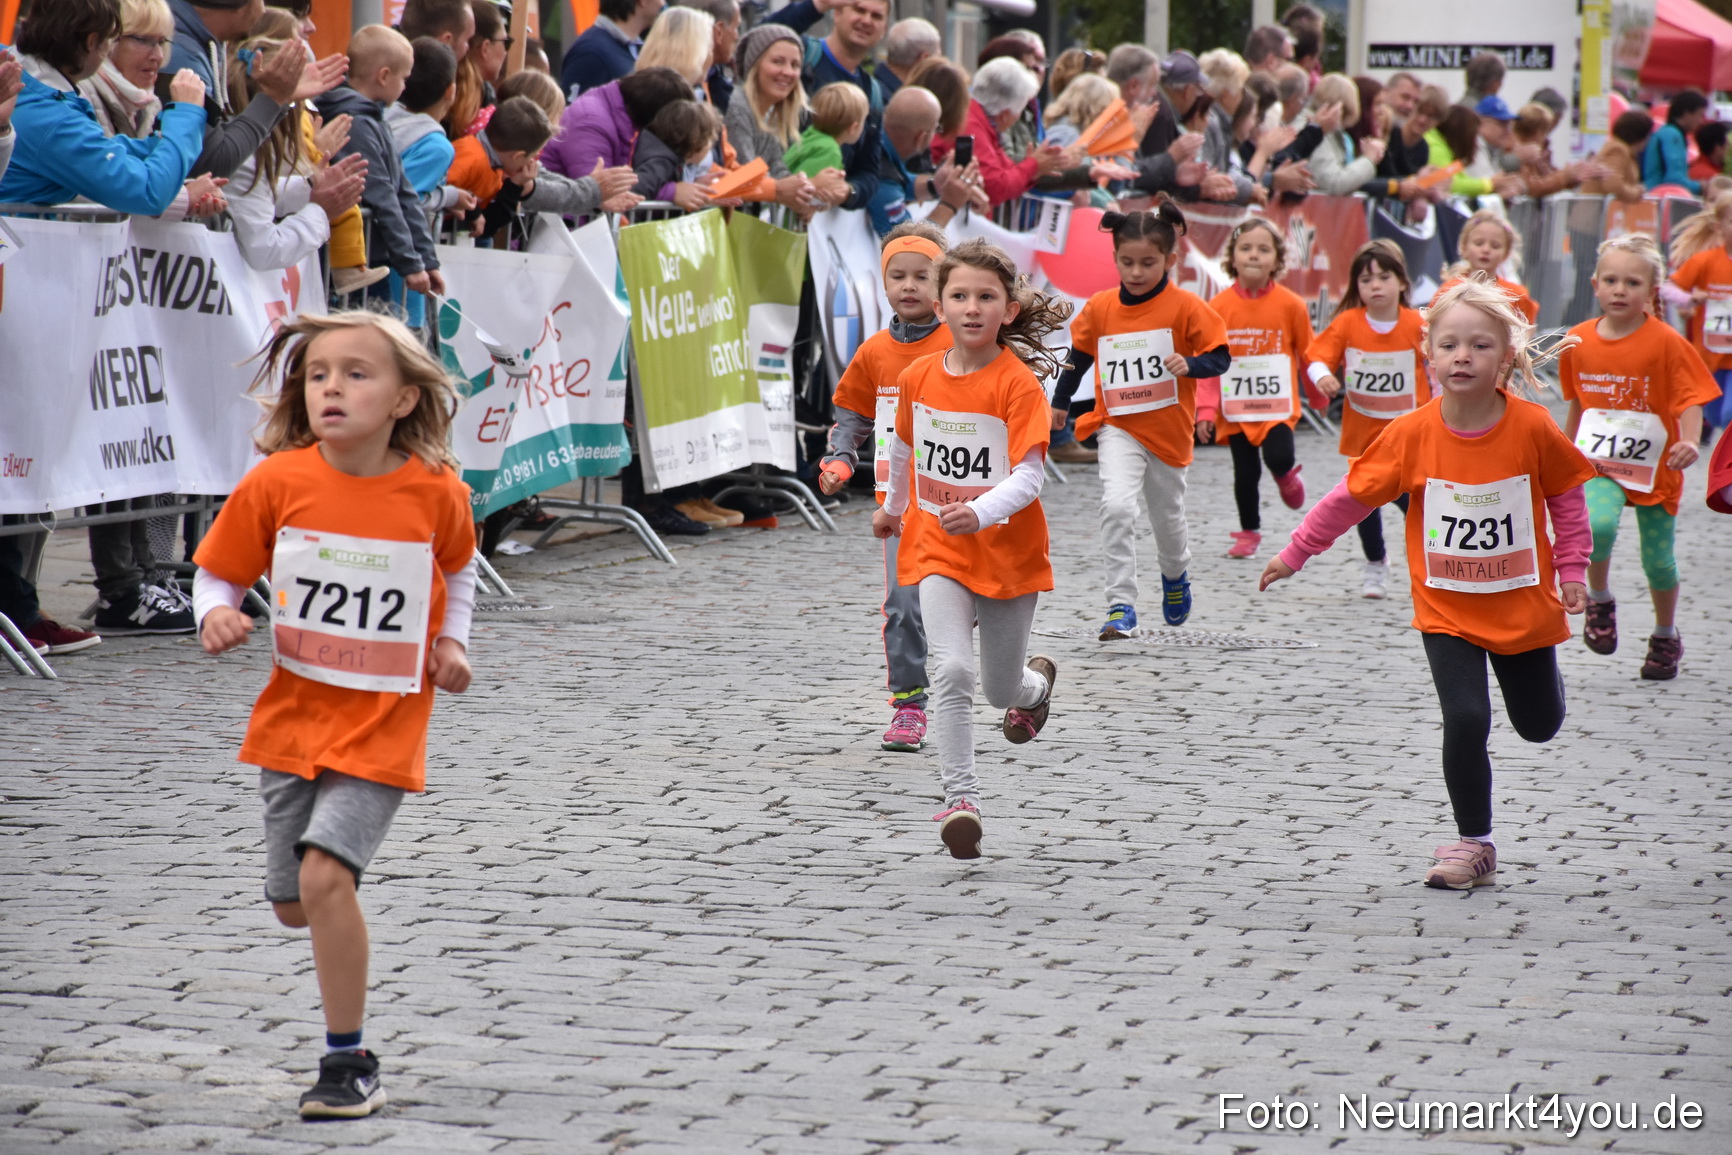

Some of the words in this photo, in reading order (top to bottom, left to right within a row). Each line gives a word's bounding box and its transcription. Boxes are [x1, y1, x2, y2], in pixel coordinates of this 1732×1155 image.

[658, 251, 680, 283] Der
[639, 285, 697, 342] Neue
[1107, 355, 1163, 385] 7113
[1353, 370, 1404, 392] 7220
[1119, 389, 1152, 400] Victoria
[1231, 376, 1280, 396] 7155
[1243, 402, 1272, 411] Johanna
[939, 420, 977, 432] BOCK
[1591, 433, 1652, 461] 7132
[3, 453, 33, 478] ZÄHLT
[923, 439, 992, 480] 7394
[1595, 463, 1633, 477] Franziska
[1463, 492, 1501, 505] BOCK
[1441, 513, 1514, 551] 7231
[334, 549, 390, 569] BOCK
[1445, 559, 1509, 578] NATALIE
[296, 577, 406, 632] 7212
[296, 632, 367, 668] Leni
